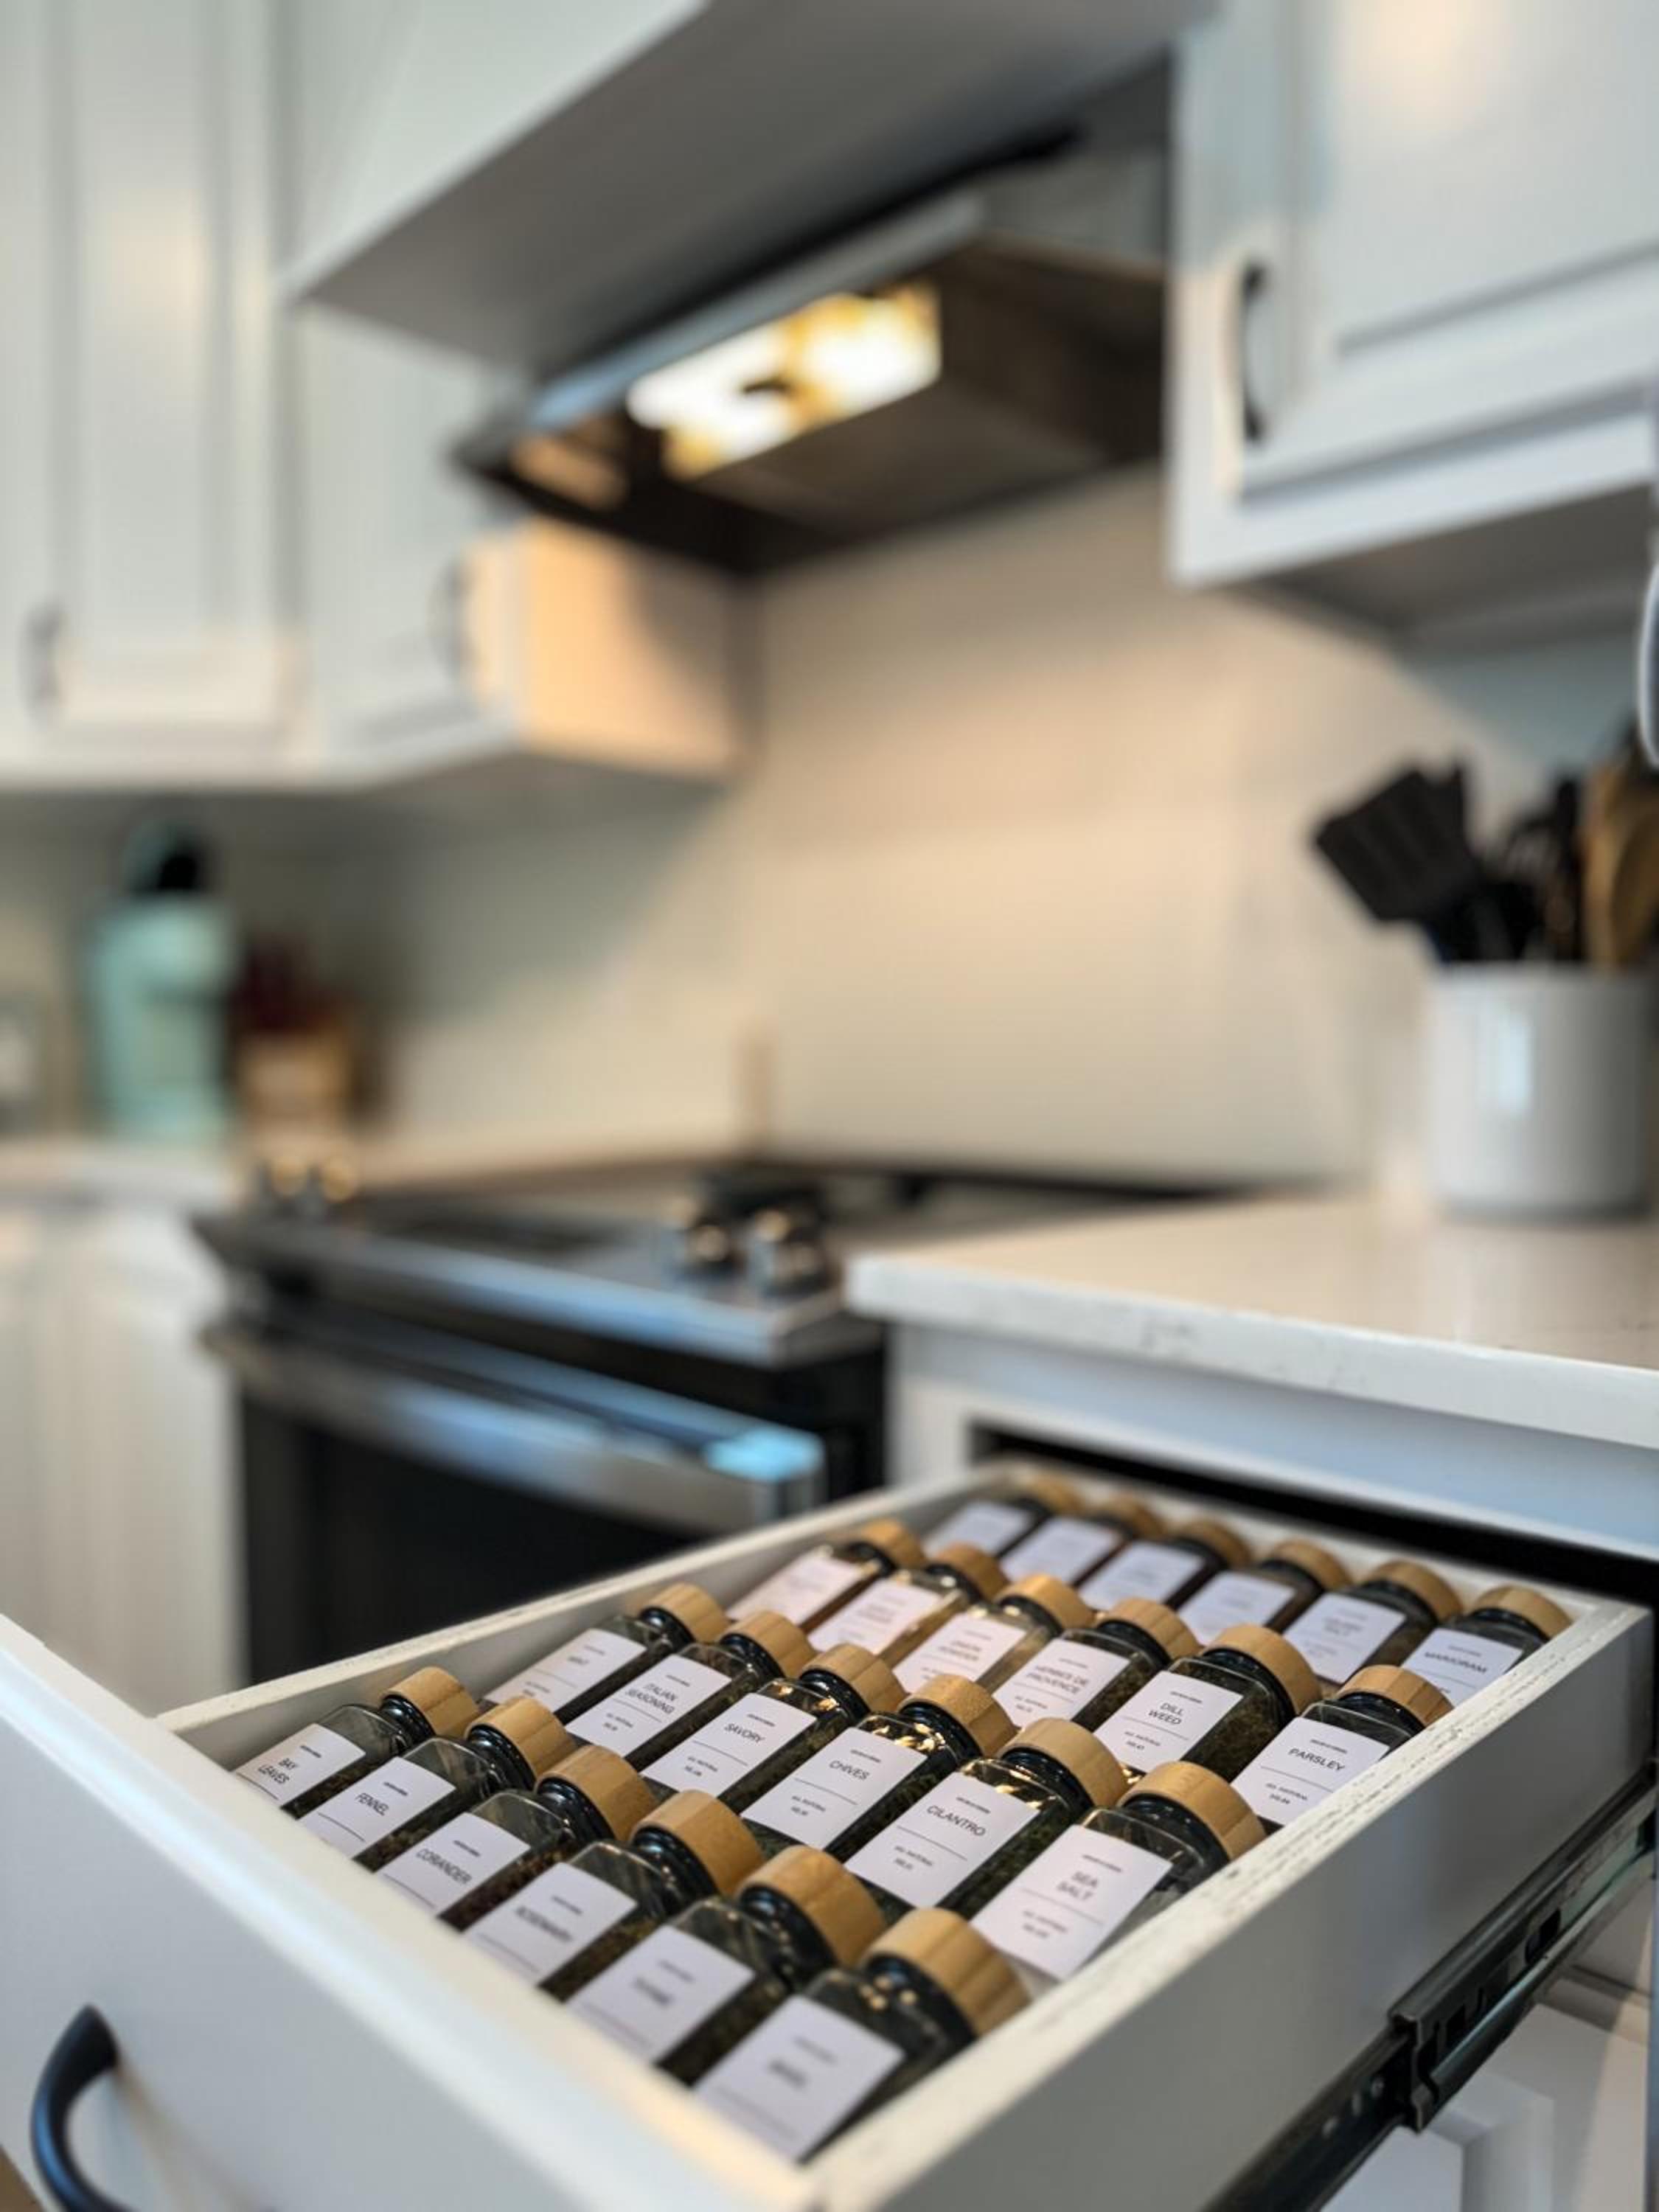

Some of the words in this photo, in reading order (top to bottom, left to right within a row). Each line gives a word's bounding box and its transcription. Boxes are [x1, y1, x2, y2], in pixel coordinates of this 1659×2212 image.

[1148, 1710, 1182, 1725] WEED
[1160, 1703, 1184, 1717] DILL
[723, 1723, 765, 1742] SAVORY
[278, 1758, 298, 1770] BAY
[1287, 1748, 1346, 1771] PARSLEY
[258, 1764, 290, 1784] LEAVES
[829, 1760, 870, 1780] CHIVES
[355, 1792, 389, 1816] FENNEL
[927, 1805, 986, 1837] CILANTRO
